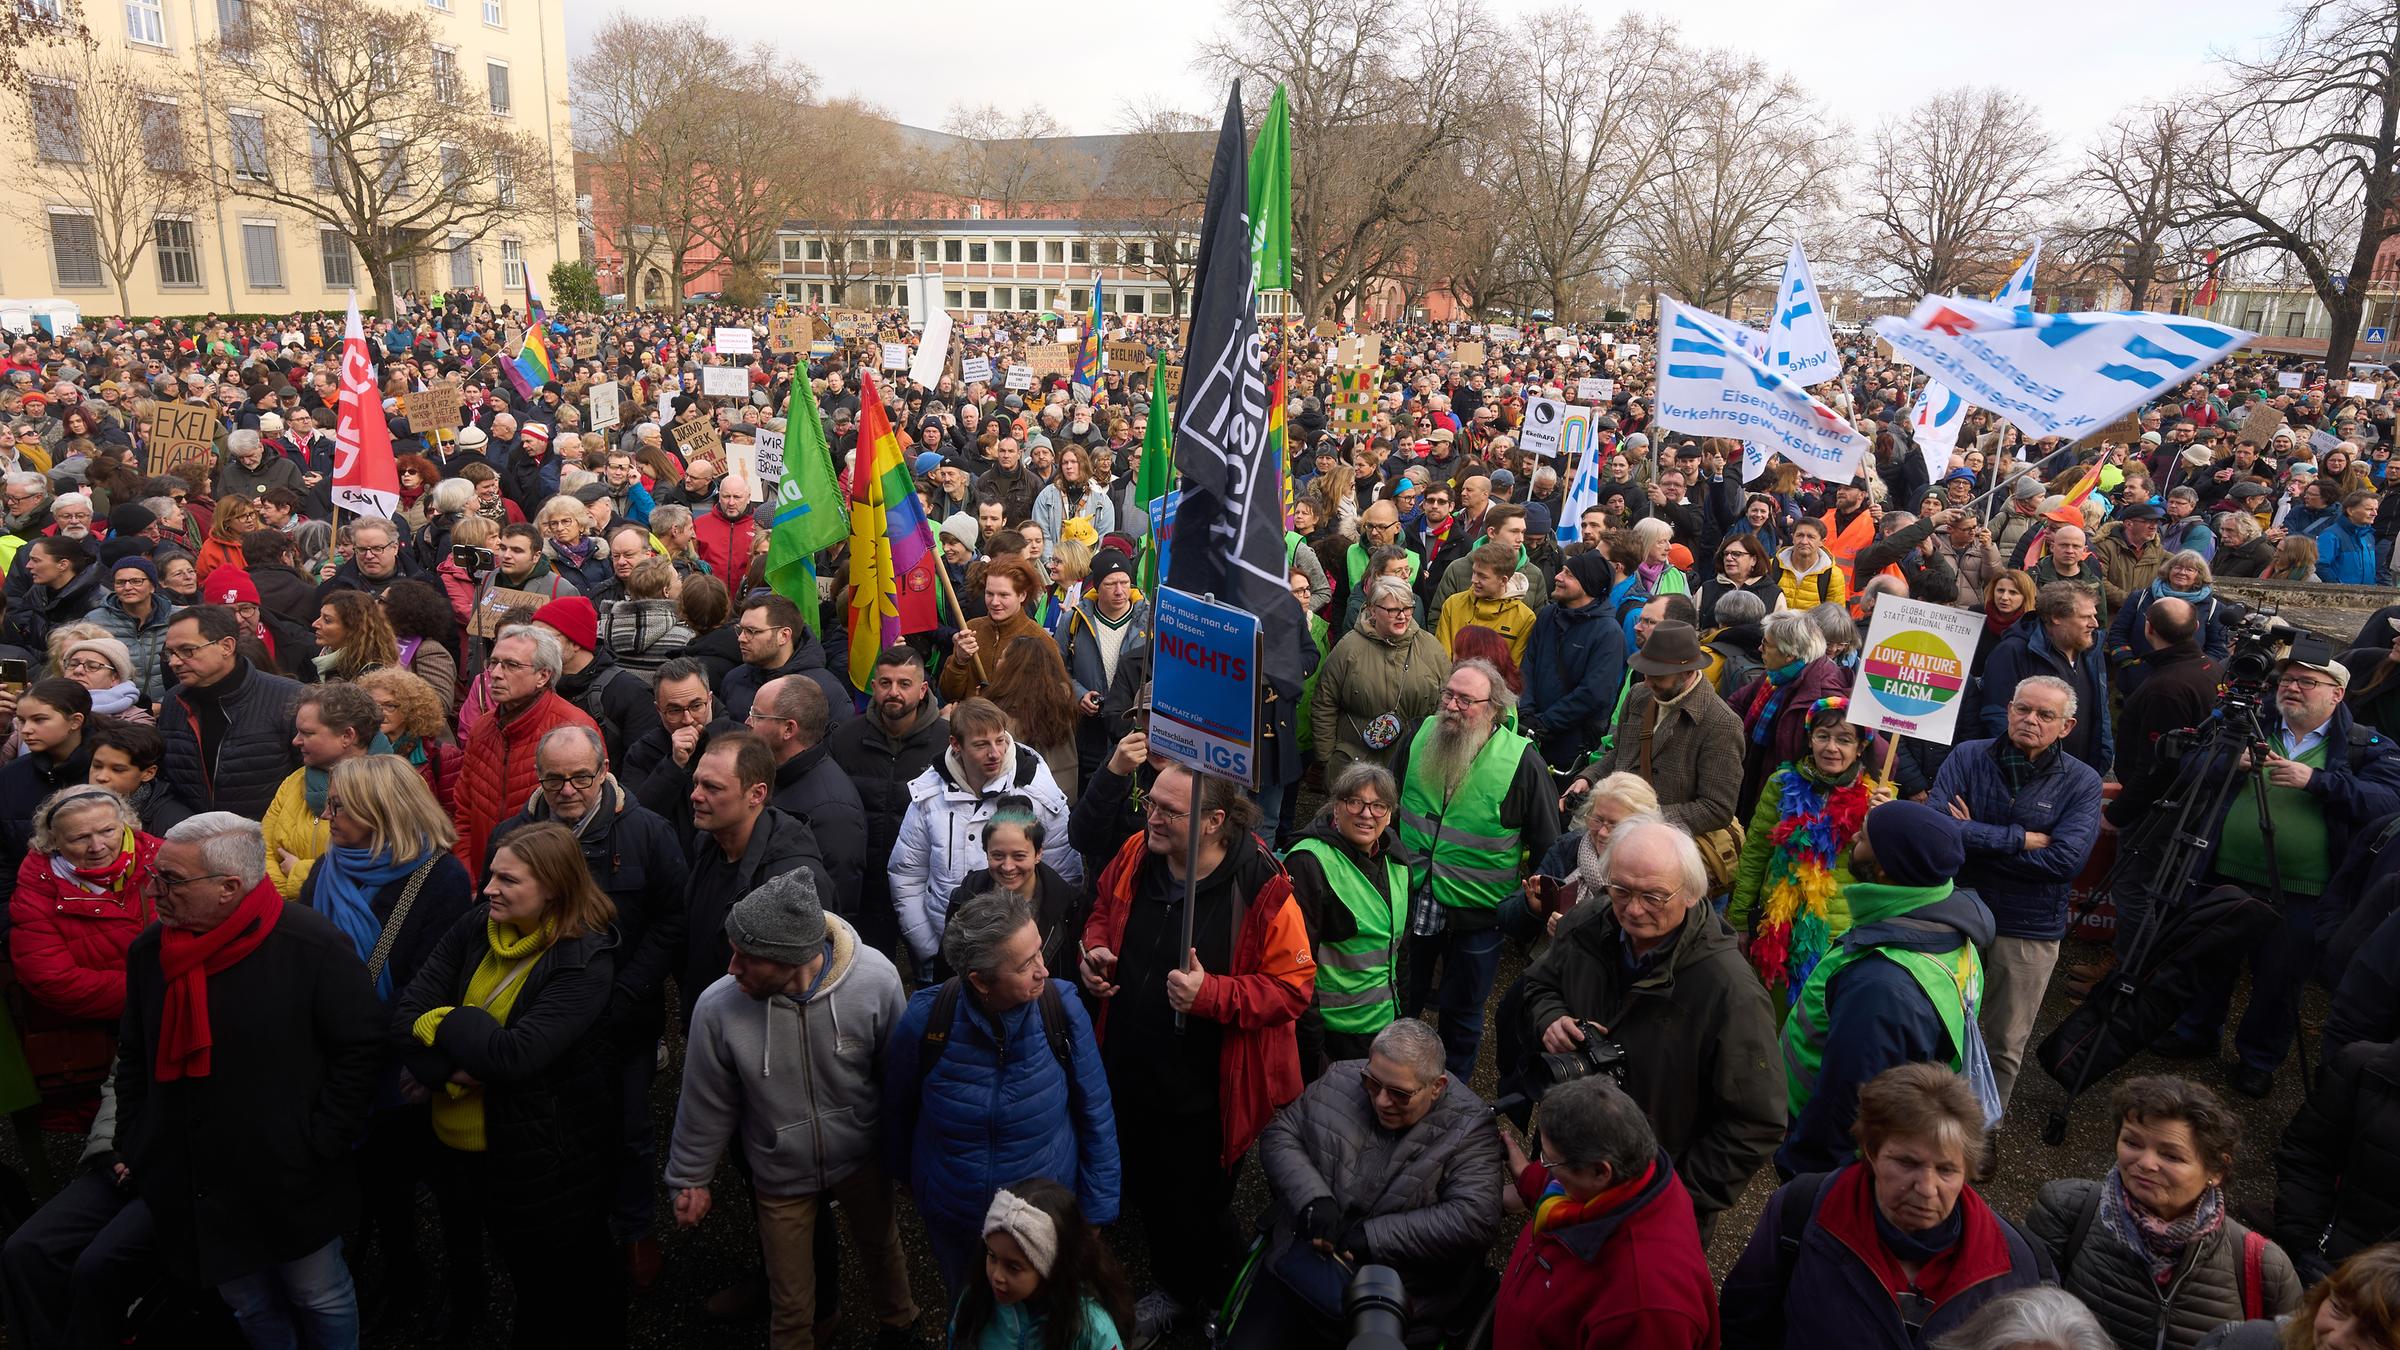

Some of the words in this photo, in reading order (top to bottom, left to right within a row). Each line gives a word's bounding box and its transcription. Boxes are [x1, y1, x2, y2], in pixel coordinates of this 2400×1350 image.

[1340, 370, 1371, 391] WIR
[1336, 392, 1370, 405] SIND
[155, 406, 211, 443] EKEL
[1334, 408, 1370, 423] MEHR
[688, 432, 714, 450] WERK
[1816, 426, 1853, 445] und
[1161, 600, 1176, 612] Eins
[1178, 608, 1198, 622] muss
[1201, 617, 1221, 629] man
[1223, 622, 1240, 634] der
[1883, 611, 1905, 623] STATT
[1908, 616, 1941, 630] NATIONAL
[1945, 624, 1972, 636] HETZEN
[1900, 605, 1926, 618] GLOBAL
[1931, 611, 1958, 624] DENKEN
[1160, 614, 1174, 625] AfD
[1176, 619, 1205, 637] lassen:
[1159, 631, 1247, 681] NICHTS
[1875, 646, 1905, 665] LOVE
[1909, 652, 1957, 674] NATURE
[1898, 666, 1932, 685] HATE
[1157, 701, 1171, 711] KEIN
[1171, 707, 1190, 719] PLATZ
[1190, 712, 1203, 722] FÜR
[1152, 725, 1195, 747] Deutschland.
[1152, 735, 1169, 747] Ohne
[1169, 741, 1180, 751] die
[1204, 741, 1247, 775] IGS
